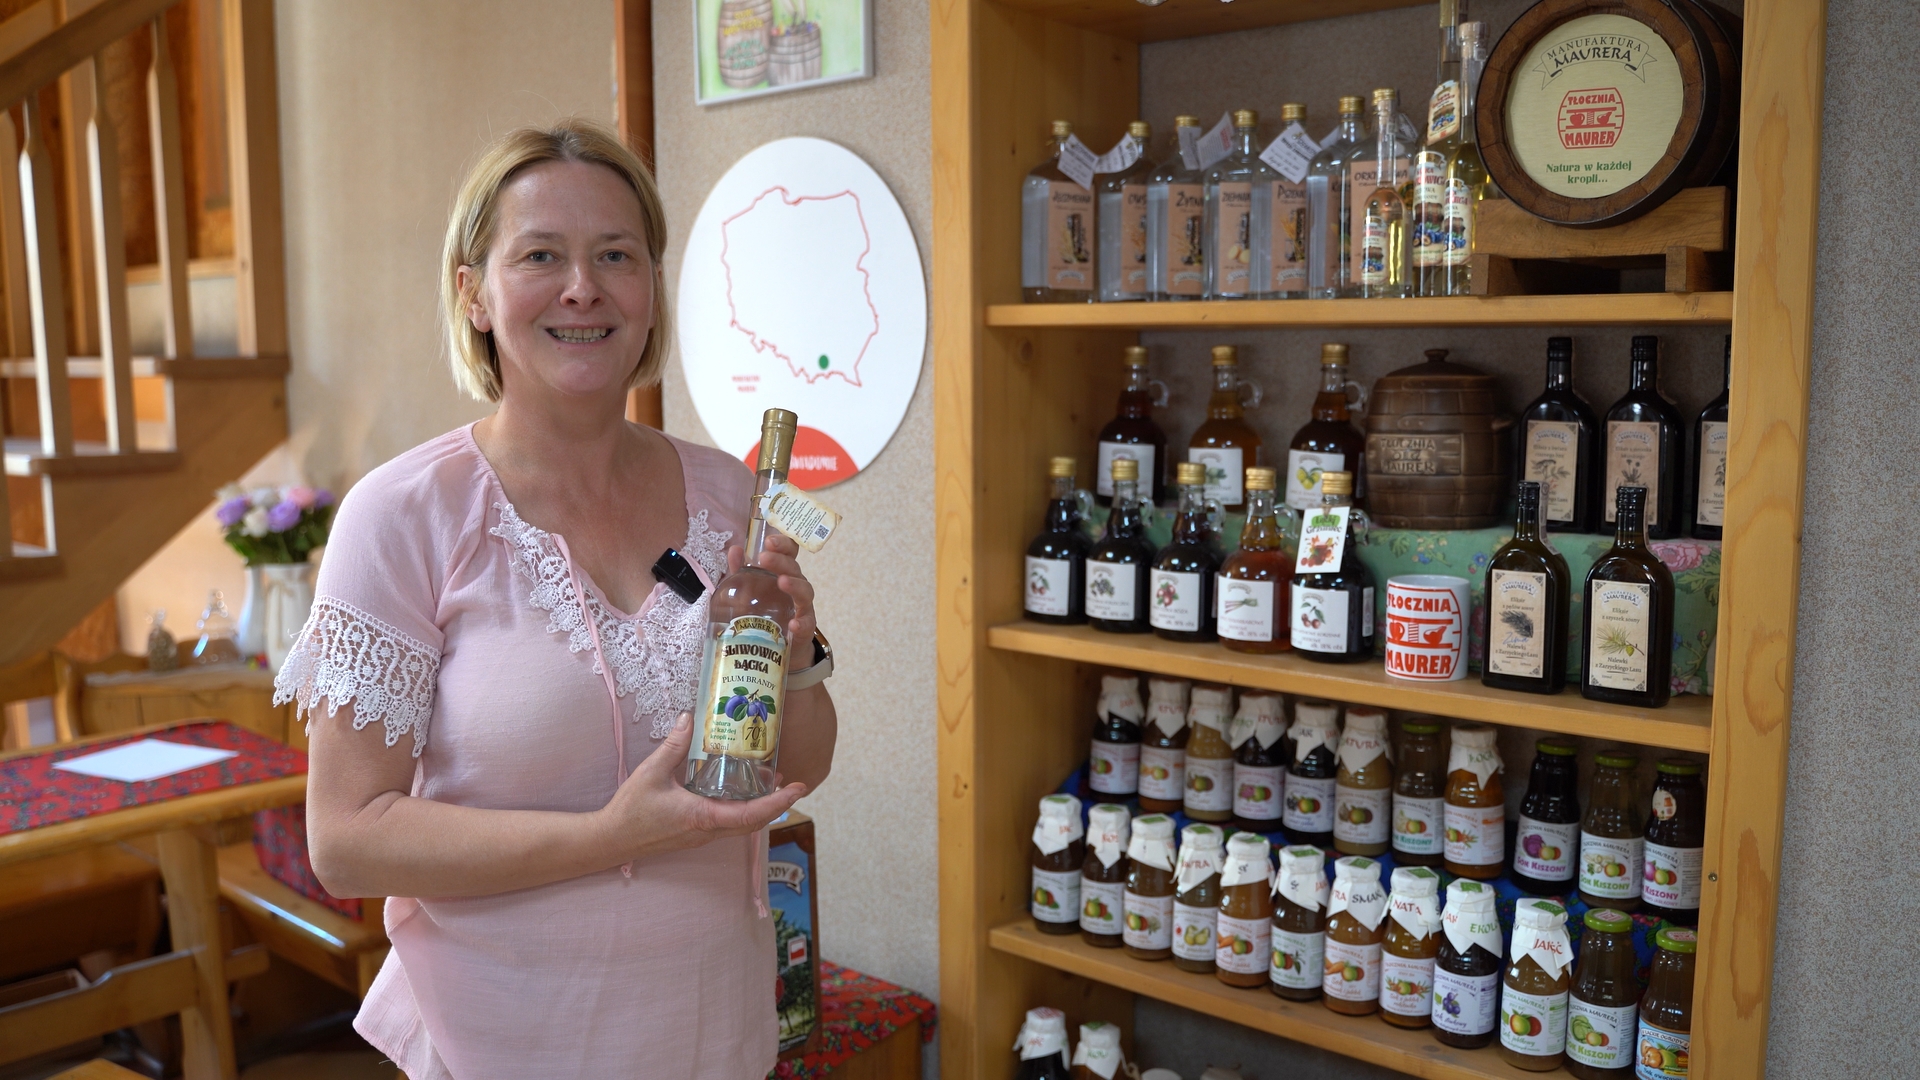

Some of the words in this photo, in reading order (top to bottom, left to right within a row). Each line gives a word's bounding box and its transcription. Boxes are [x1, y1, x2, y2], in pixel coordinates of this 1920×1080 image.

[1548, 36, 1642, 60] MANUFAKTURA
[1554, 46, 1631, 68] MAURERA
[1567, 94, 1615, 106] TŁOCZNIA
[1565, 130, 1615, 146] MAURER
[1546, 162, 1580, 173] Natura
[1584, 163, 1594, 172] w
[1596, 160, 1632, 172] każdej
[1567, 174, 1608, 185] kropli...
[1387, 592, 1451, 613] TŁOCZNIA
[1612, 607, 1629, 615] Eliksir
[739, 623, 775, 634] MAURERA
[1506, 642, 1527, 650] Nalewki
[1386, 648, 1451, 675] MAURER
[1607, 656, 1628, 665] Nalewki
[1598, 662, 1629, 673] Zarzyckiego
[722, 675, 745, 684] PLUM
[745, 675, 776, 691] BRANDY
[745, 726, 767, 741] 70%
[1531, 861, 1566, 873] KISZONY
[1593, 878, 1630, 890] KISZONY
[1645, 885, 1679, 900] KISZONY
[1588, 1008, 1618, 1024] MAURERA
[1660, 1034, 1684, 1045] OGRODY
[1577, 1045, 1617, 1060] KISZONY
